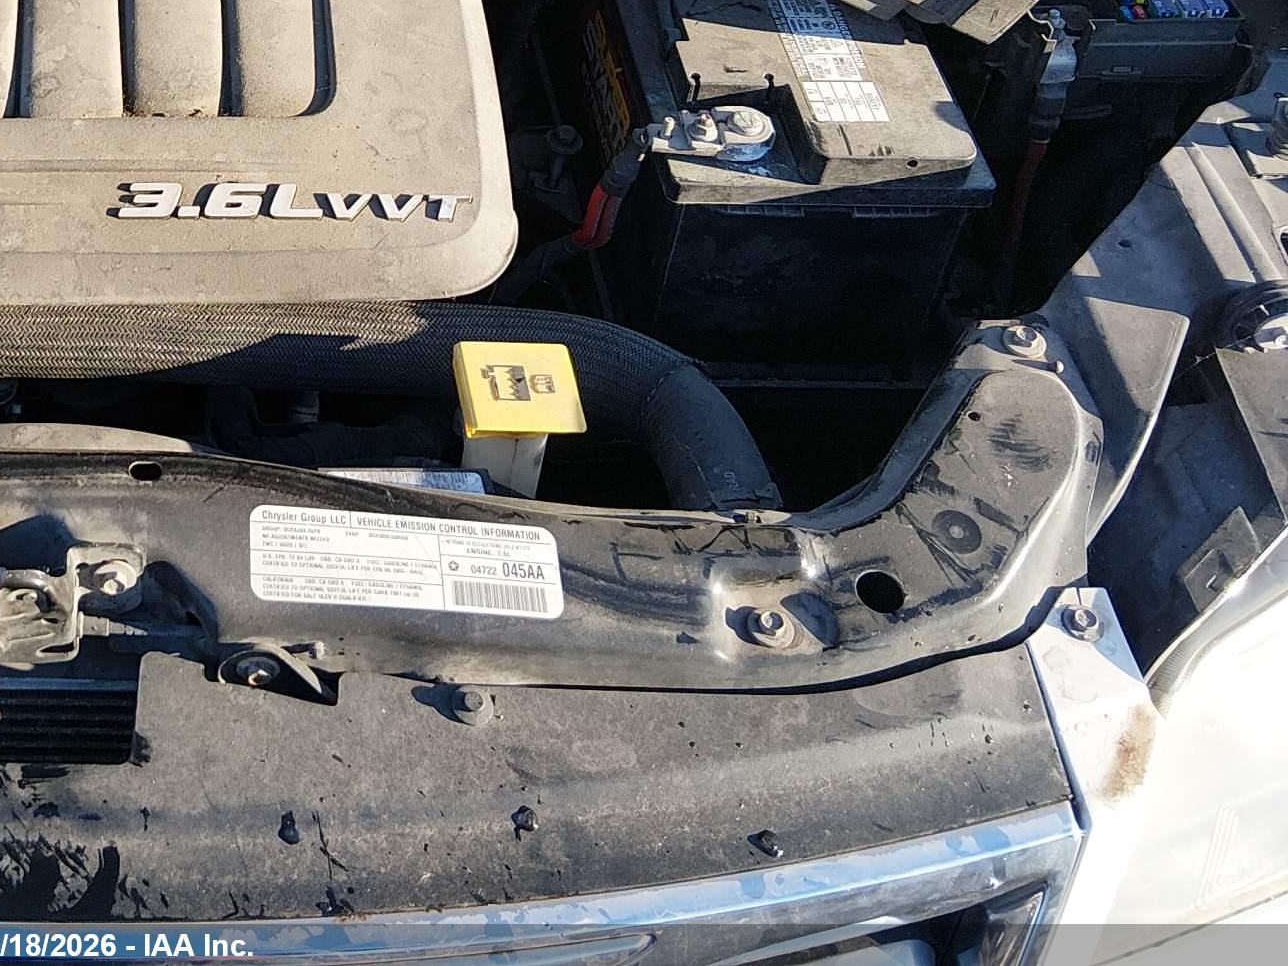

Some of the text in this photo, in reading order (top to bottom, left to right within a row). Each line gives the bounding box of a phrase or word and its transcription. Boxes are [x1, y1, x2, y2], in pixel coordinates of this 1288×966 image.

[262, 510, 346, 524] Chrysler Group LLC
[356, 517, 541, 540] VEHICLE EMISSION CONTROL INFORMATION
[470, 562, 545, 580] 04722 045AA
